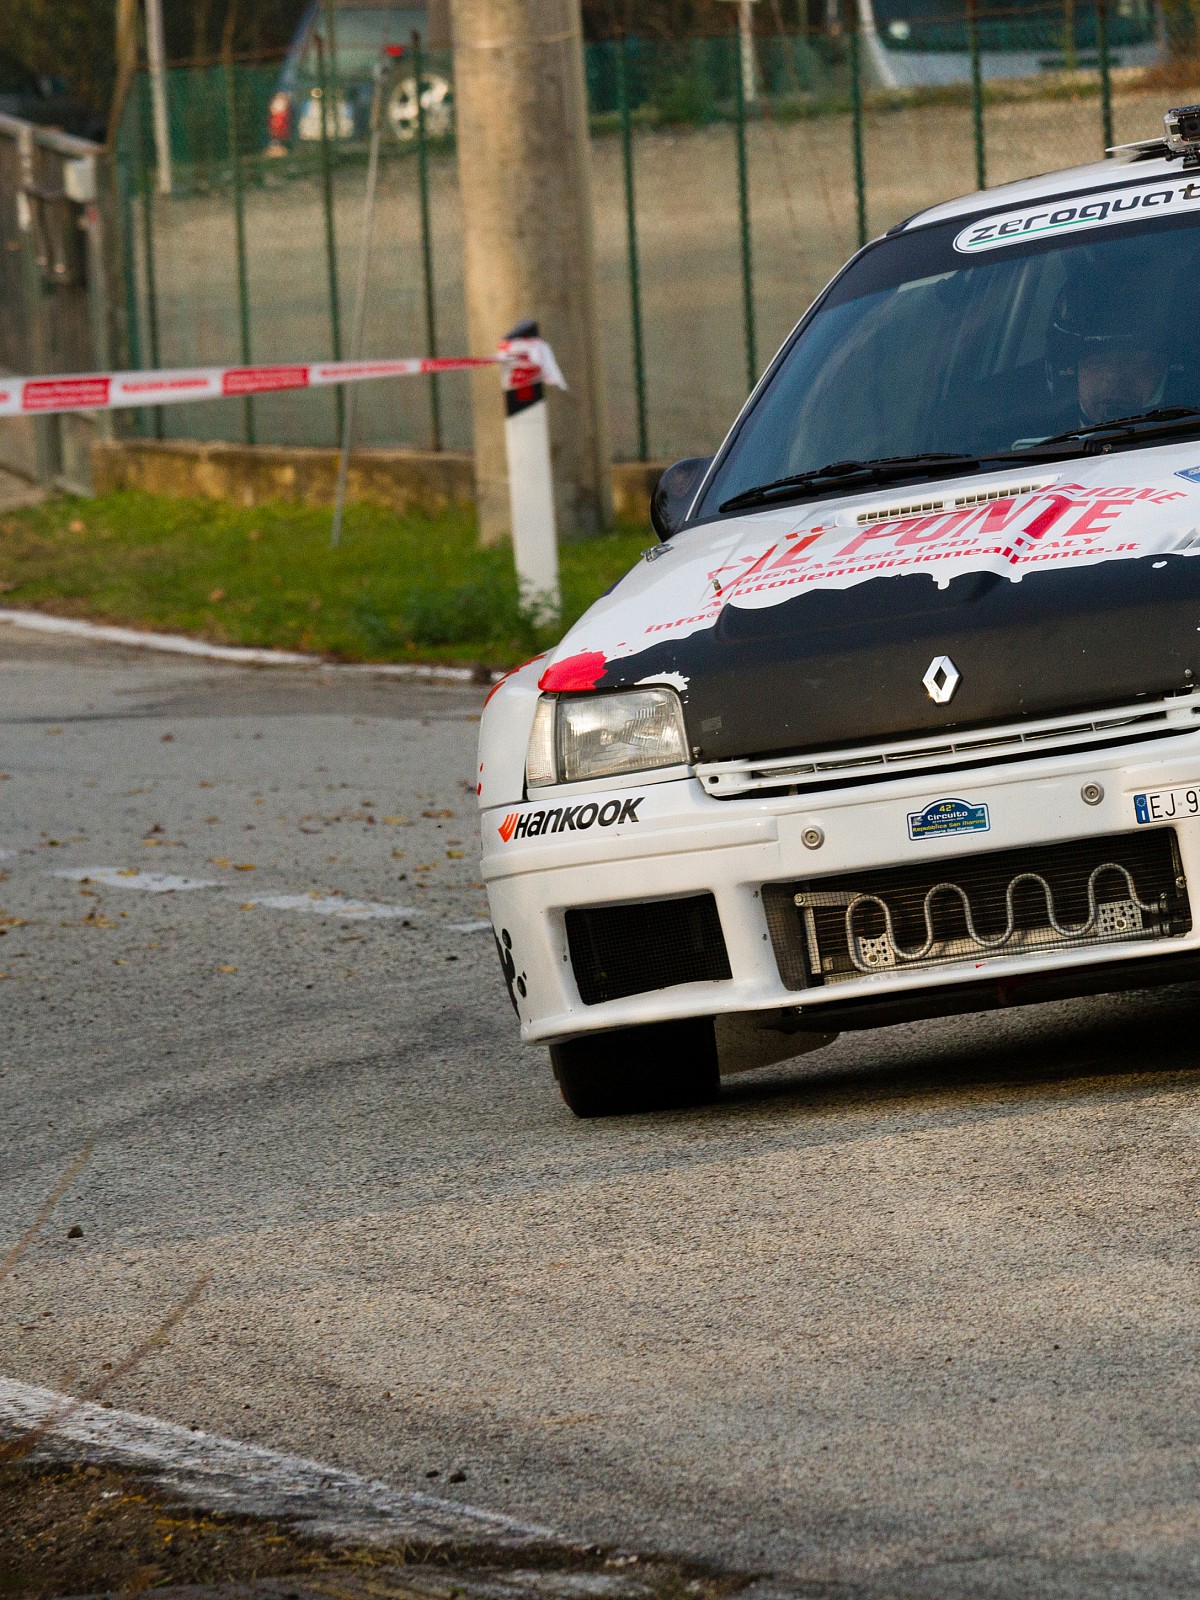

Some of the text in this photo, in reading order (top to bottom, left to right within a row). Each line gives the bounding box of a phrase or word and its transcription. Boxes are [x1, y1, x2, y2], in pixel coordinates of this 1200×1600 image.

[833, 494, 1135, 557] PONTE
[917, 537, 979, 553] (PD)
[927, 810, 969, 821] Circuito
[1149, 793, 1176, 819] EJ
